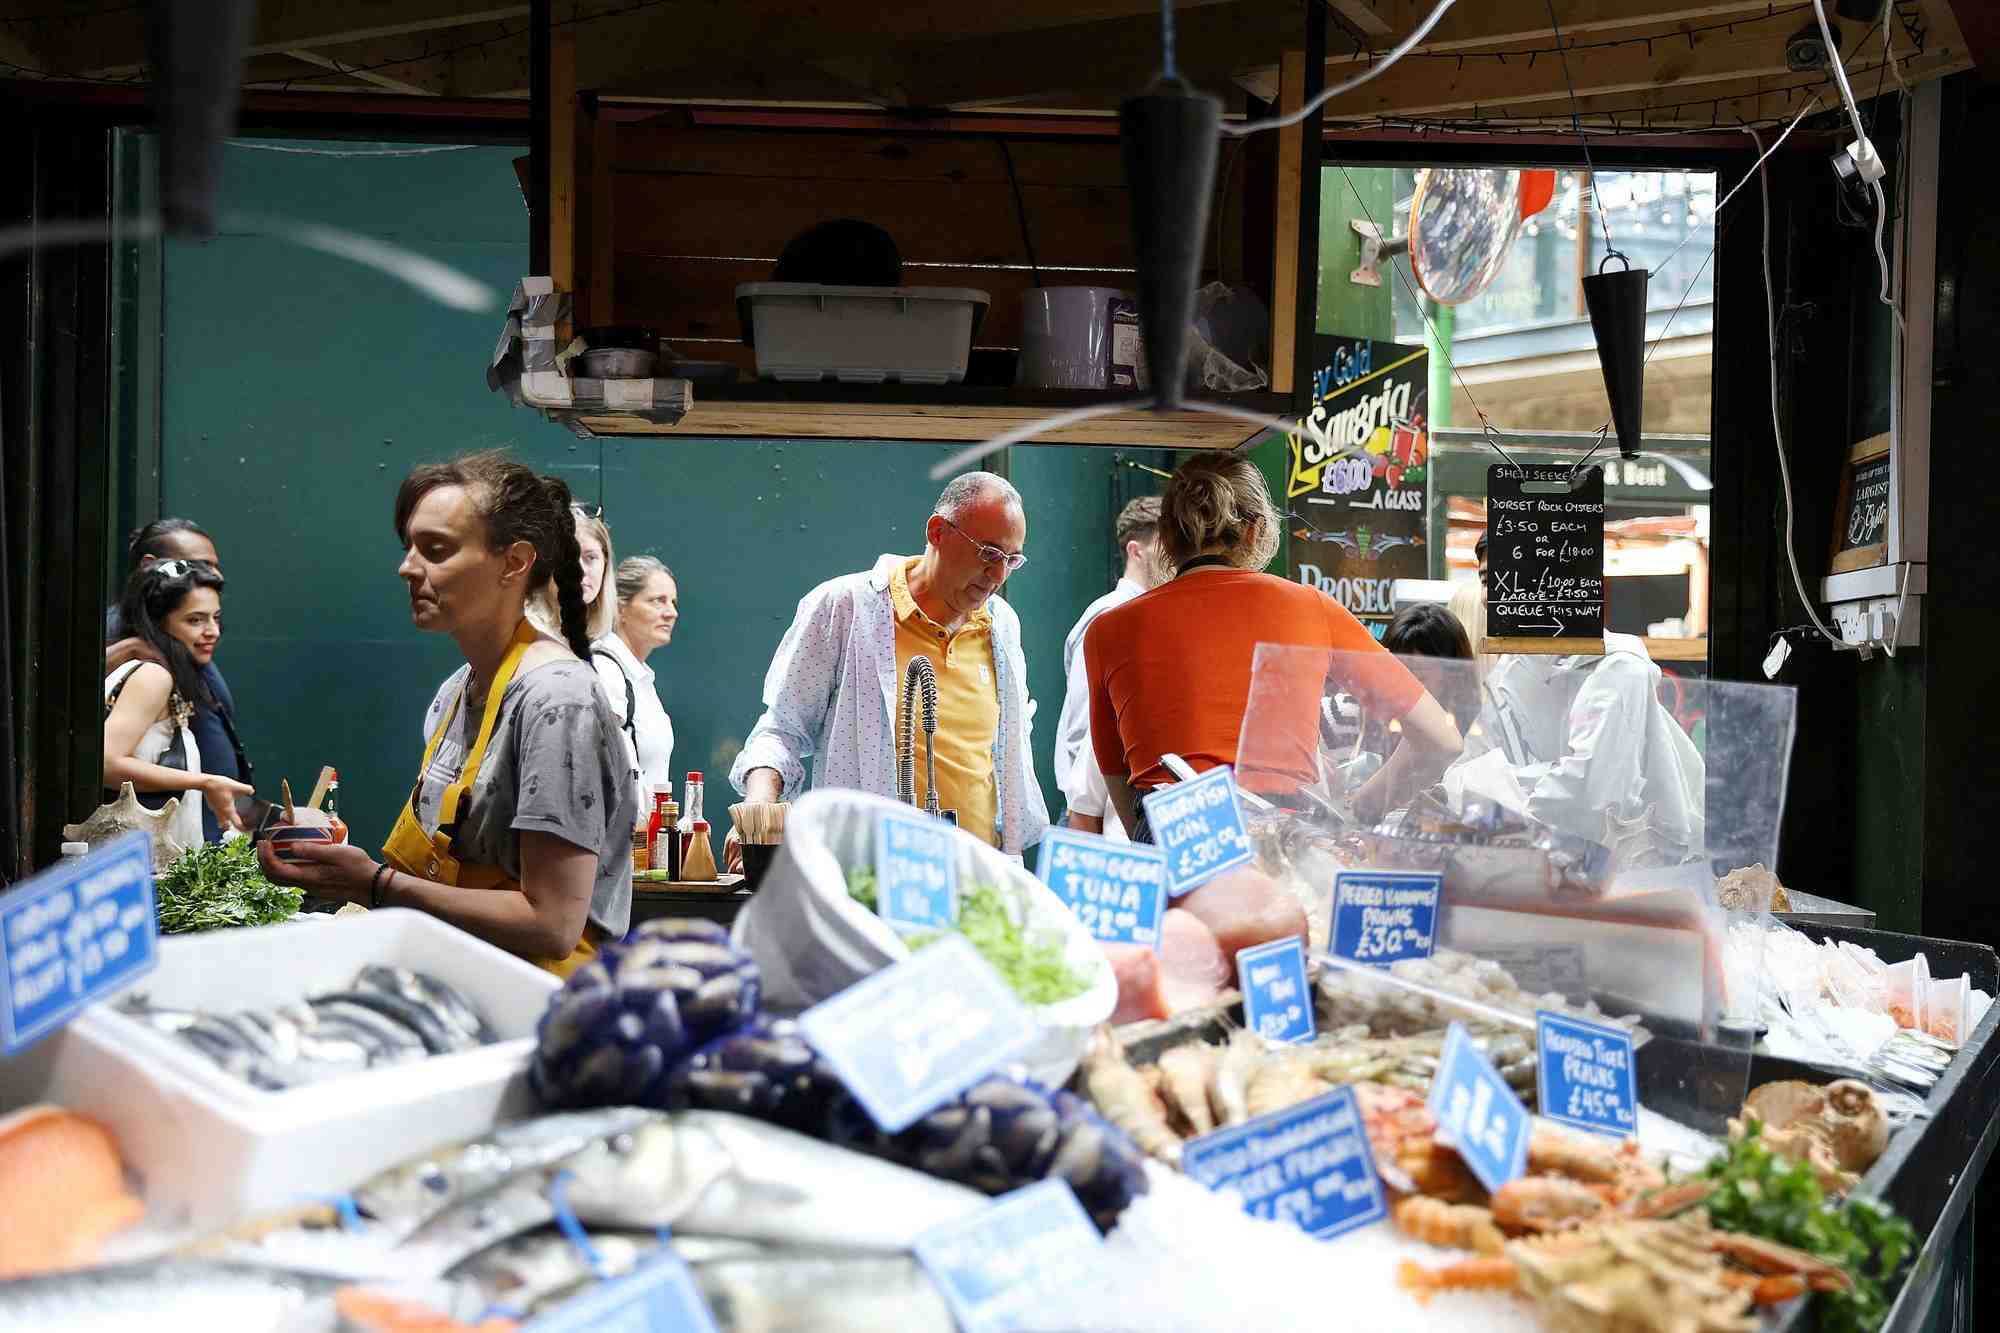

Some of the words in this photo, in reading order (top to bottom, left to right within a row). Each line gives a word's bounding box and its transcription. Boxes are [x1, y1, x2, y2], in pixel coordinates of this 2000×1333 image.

[1333, 337, 1372, 386] Cold
[1304, 378, 1412, 463] Sangria
[1373, 491, 1385, 509] A
[1387, 489, 1423, 509] GLASS
[1856, 481, 1889, 502] LARGEST
[1492, 499, 1535, 511] DORSET
[1538, 501, 1563, 512] ROCK
[1565, 502, 1604, 513] OYSTERS
[1496, 514, 1539, 536] £3.50
[1551, 521, 1587, 534] EACH
[1535, 535, 1550, 544] OR
[1512, 546, 1523, 559] 6
[1536, 547, 1556, 558] FOR
[1559, 539, 1594, 563] £18.00
[1299, 564, 1396, 613] PROSEC
[1580, 578, 1602, 588] EACH
[1500, 590, 1547, 602] LARGE
[1556, 586, 1589, 602] £7.50
[1496, 604, 1545, 617] QUEUE
[1546, 605, 1572, 617] THIS
[1575, 605, 1601, 618] WAY
[1065, 872, 1141, 912] TUNA
